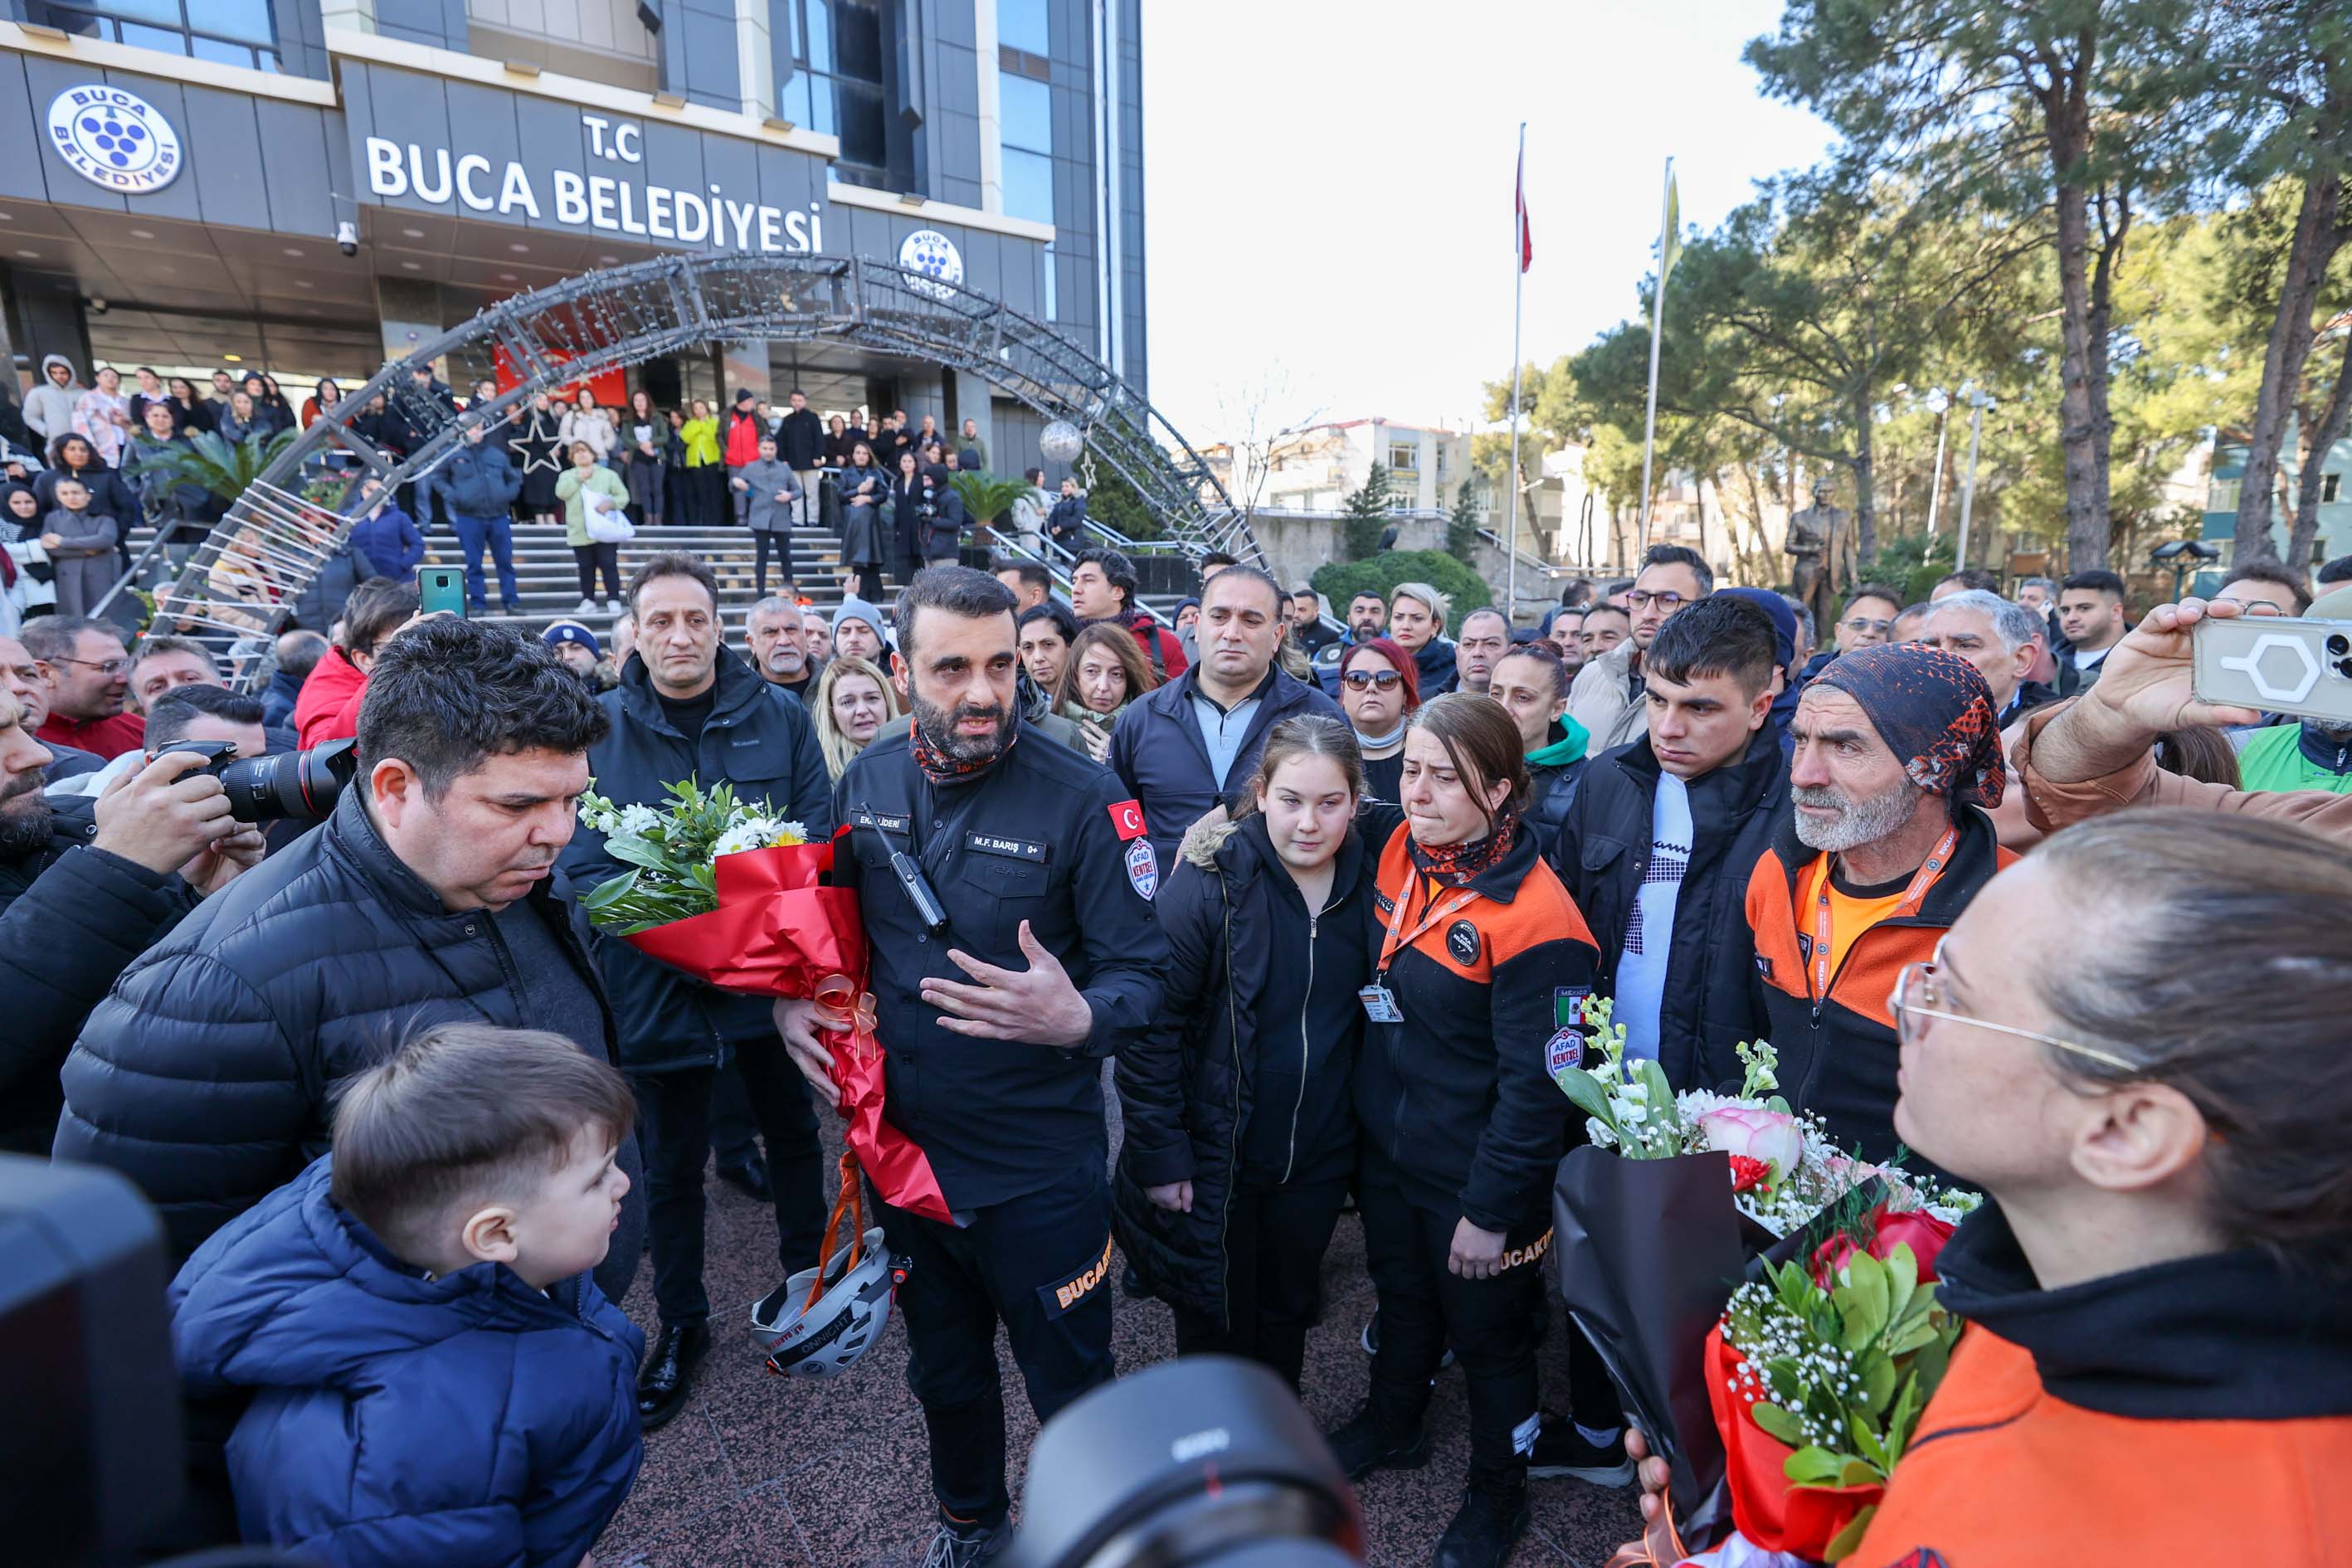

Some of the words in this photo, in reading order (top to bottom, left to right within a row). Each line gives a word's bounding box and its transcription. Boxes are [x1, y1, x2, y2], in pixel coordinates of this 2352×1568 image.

[71, 90, 147, 117] BUCA
[582, 115, 641, 163] T.C
[366, 136, 540, 219] BUCA
[553, 169, 823, 255] BELEDİYESİ
[974, 836, 991, 847] M.F.
[992, 840, 1020, 854] BARIŞ
[1133, 851, 1149, 863] AFAD
[1132, 861, 1153, 877] KENTSEL
[1555, 1039, 1576, 1053] AFAD
[1552, 1048, 1580, 1065] KENTSEL
[801, 1313, 850, 1354] ONNIGHT
